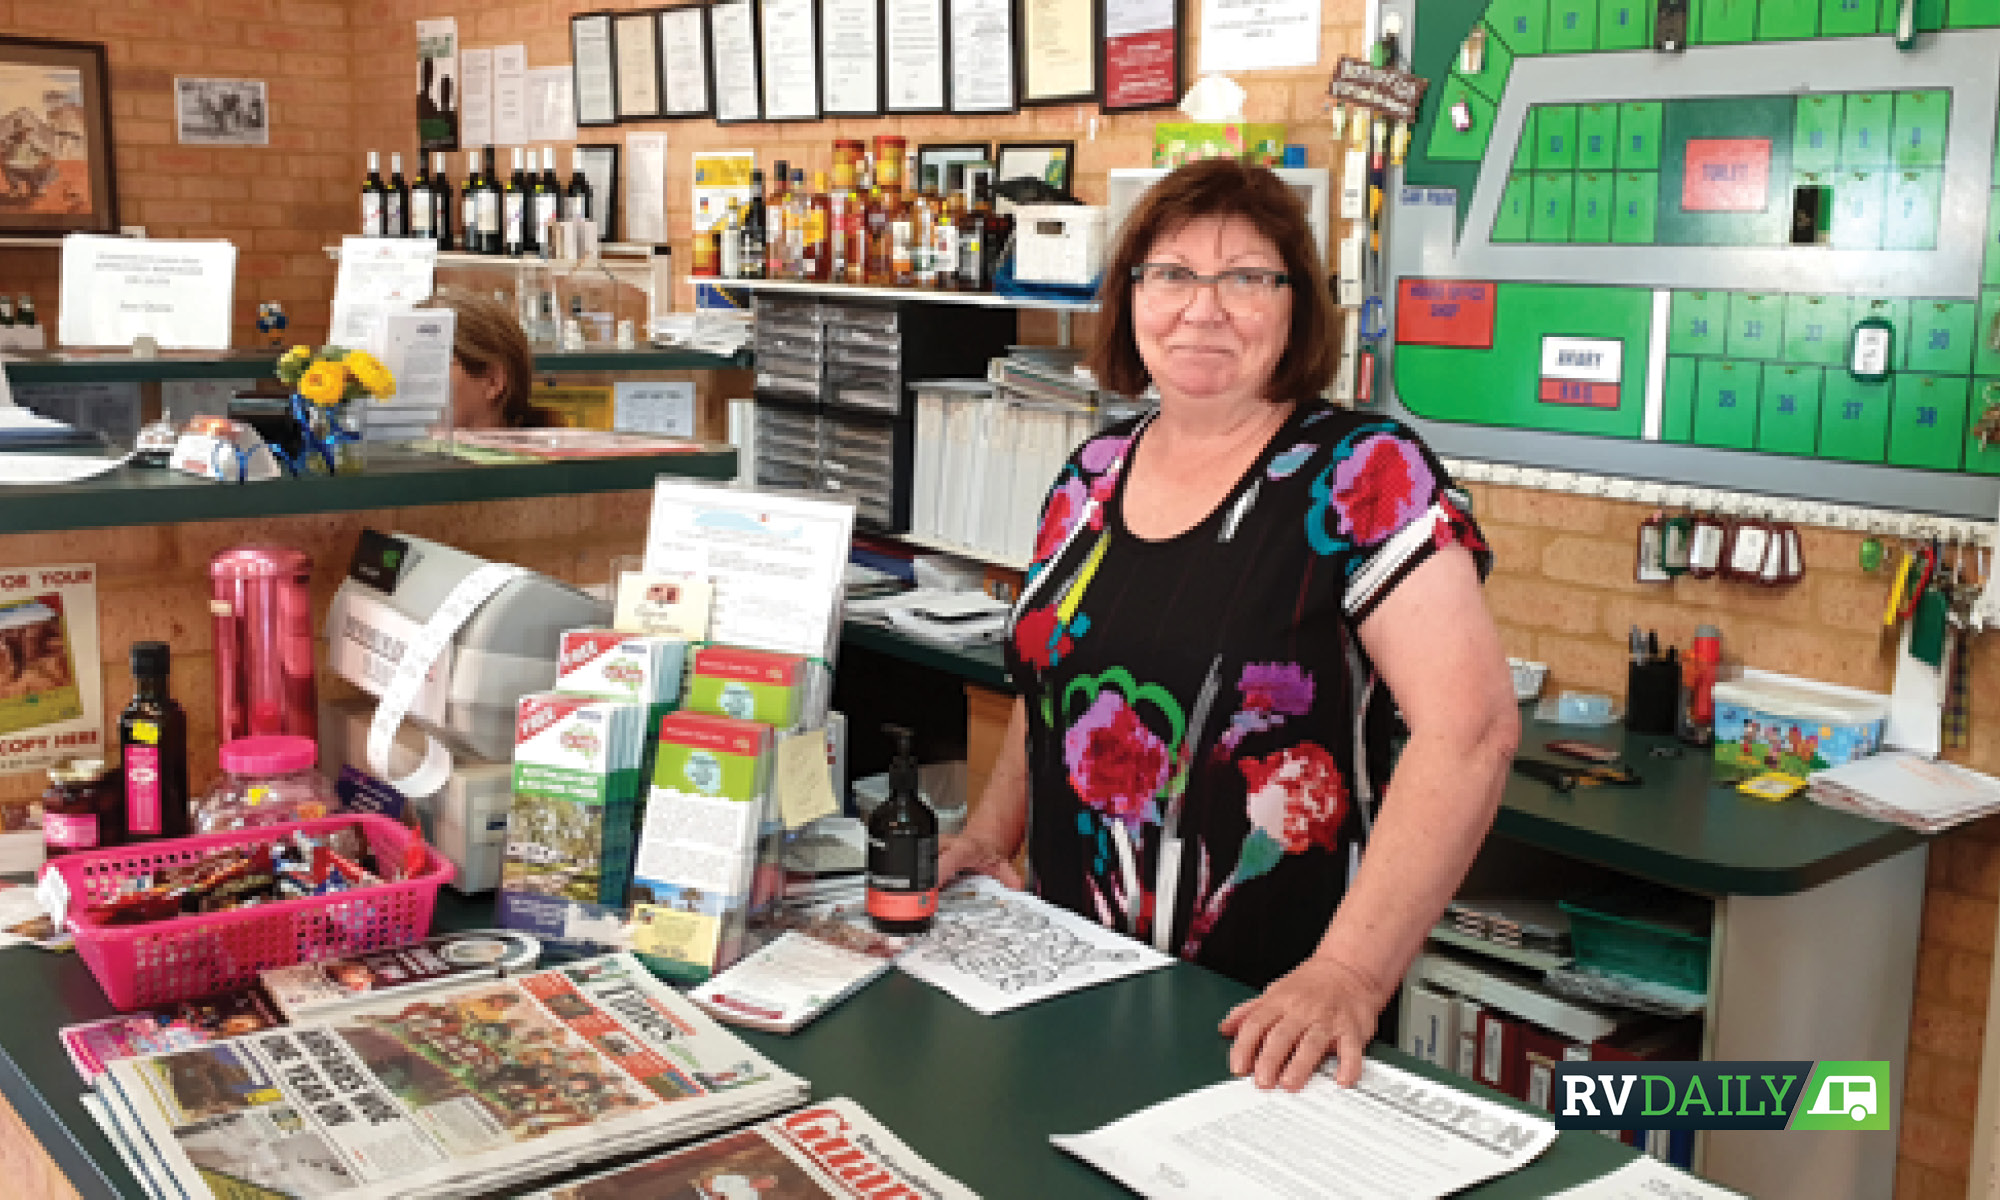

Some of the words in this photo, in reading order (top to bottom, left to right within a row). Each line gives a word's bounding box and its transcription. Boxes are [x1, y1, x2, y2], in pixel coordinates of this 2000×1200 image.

[1717, 389, 1737, 409] 35
[1842, 400, 1864, 422] 37
[0, 574, 30, 592] OR
[39, 570, 93, 588] YOUR
[53, 729, 98, 746] HERE
[284, 1066, 335, 1106] YEAR
